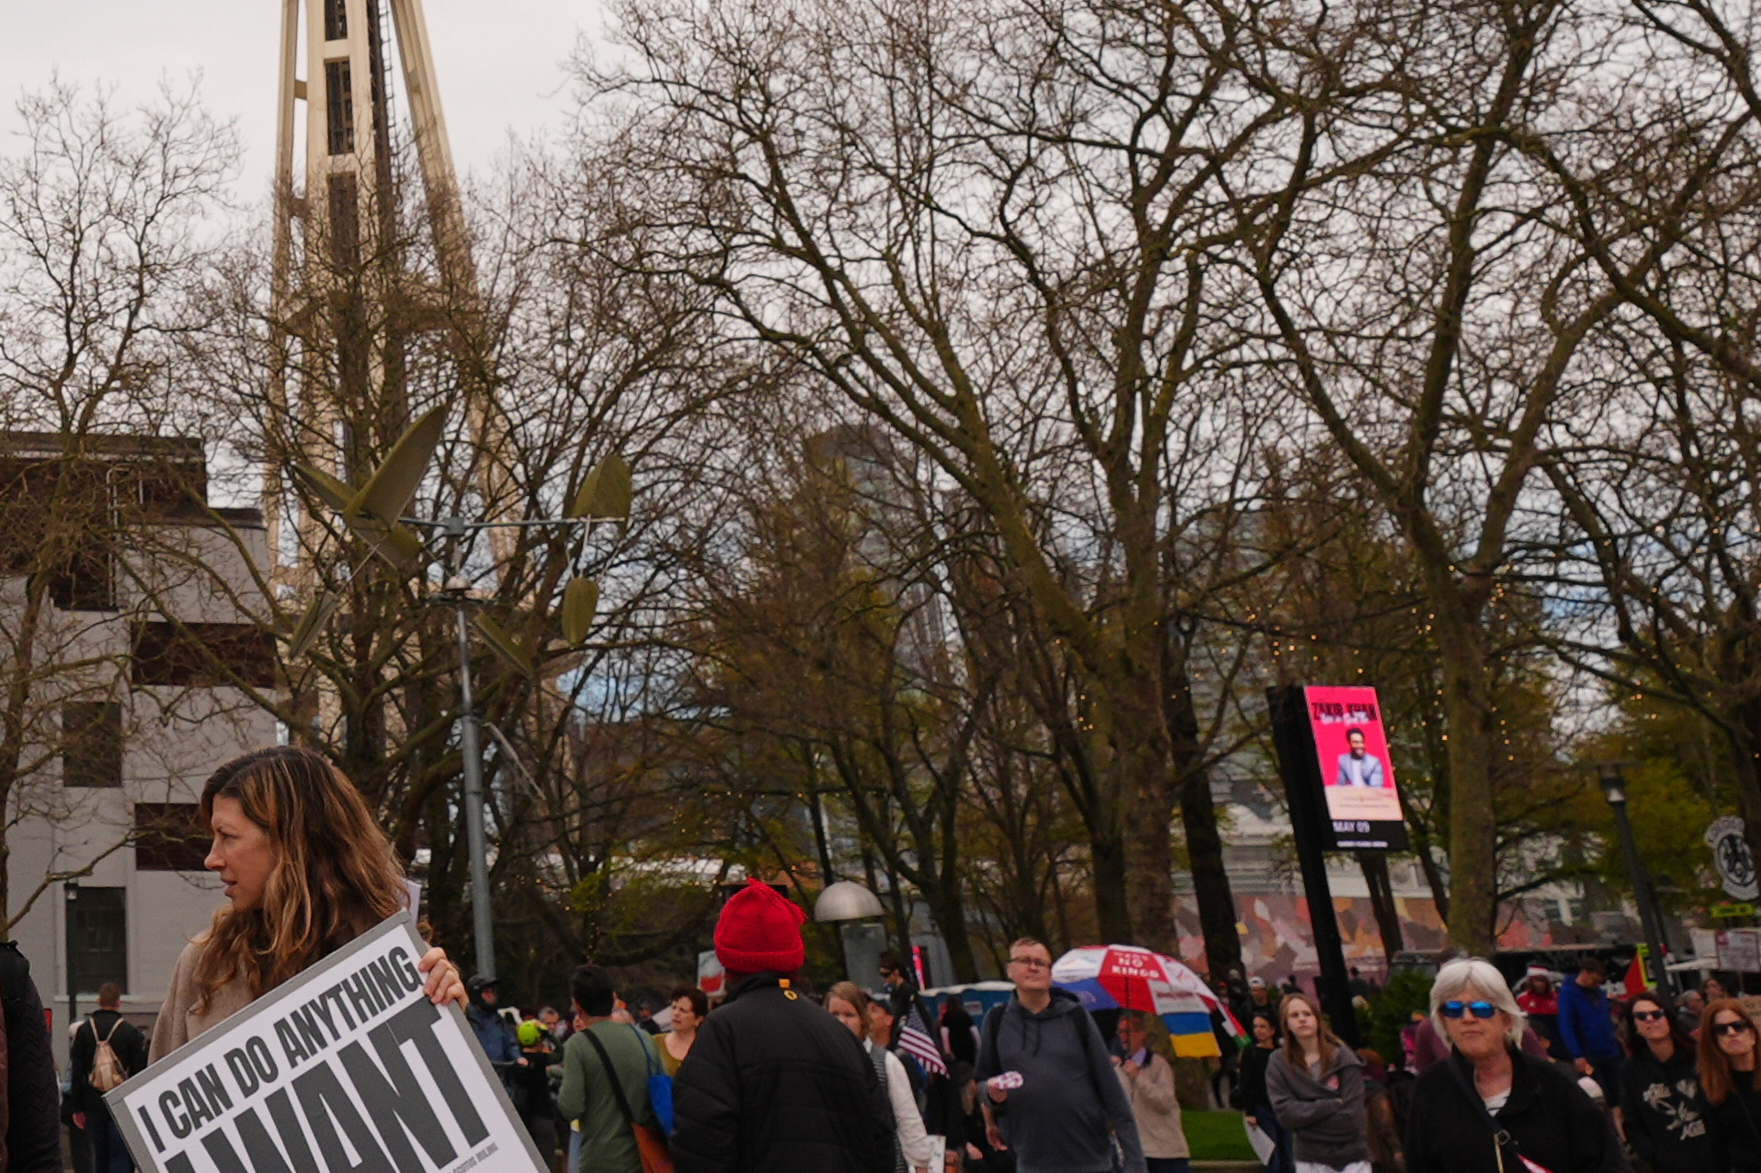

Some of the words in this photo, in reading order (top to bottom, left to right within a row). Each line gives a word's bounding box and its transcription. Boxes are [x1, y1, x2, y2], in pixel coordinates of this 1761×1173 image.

[1118, 958, 1143, 968] NO
[137, 1103, 166, 1154] I
[158, 1062, 233, 1140] CAN
[223, 1034, 280, 1099] DO
[272, 945, 425, 1069] ANYTHING
